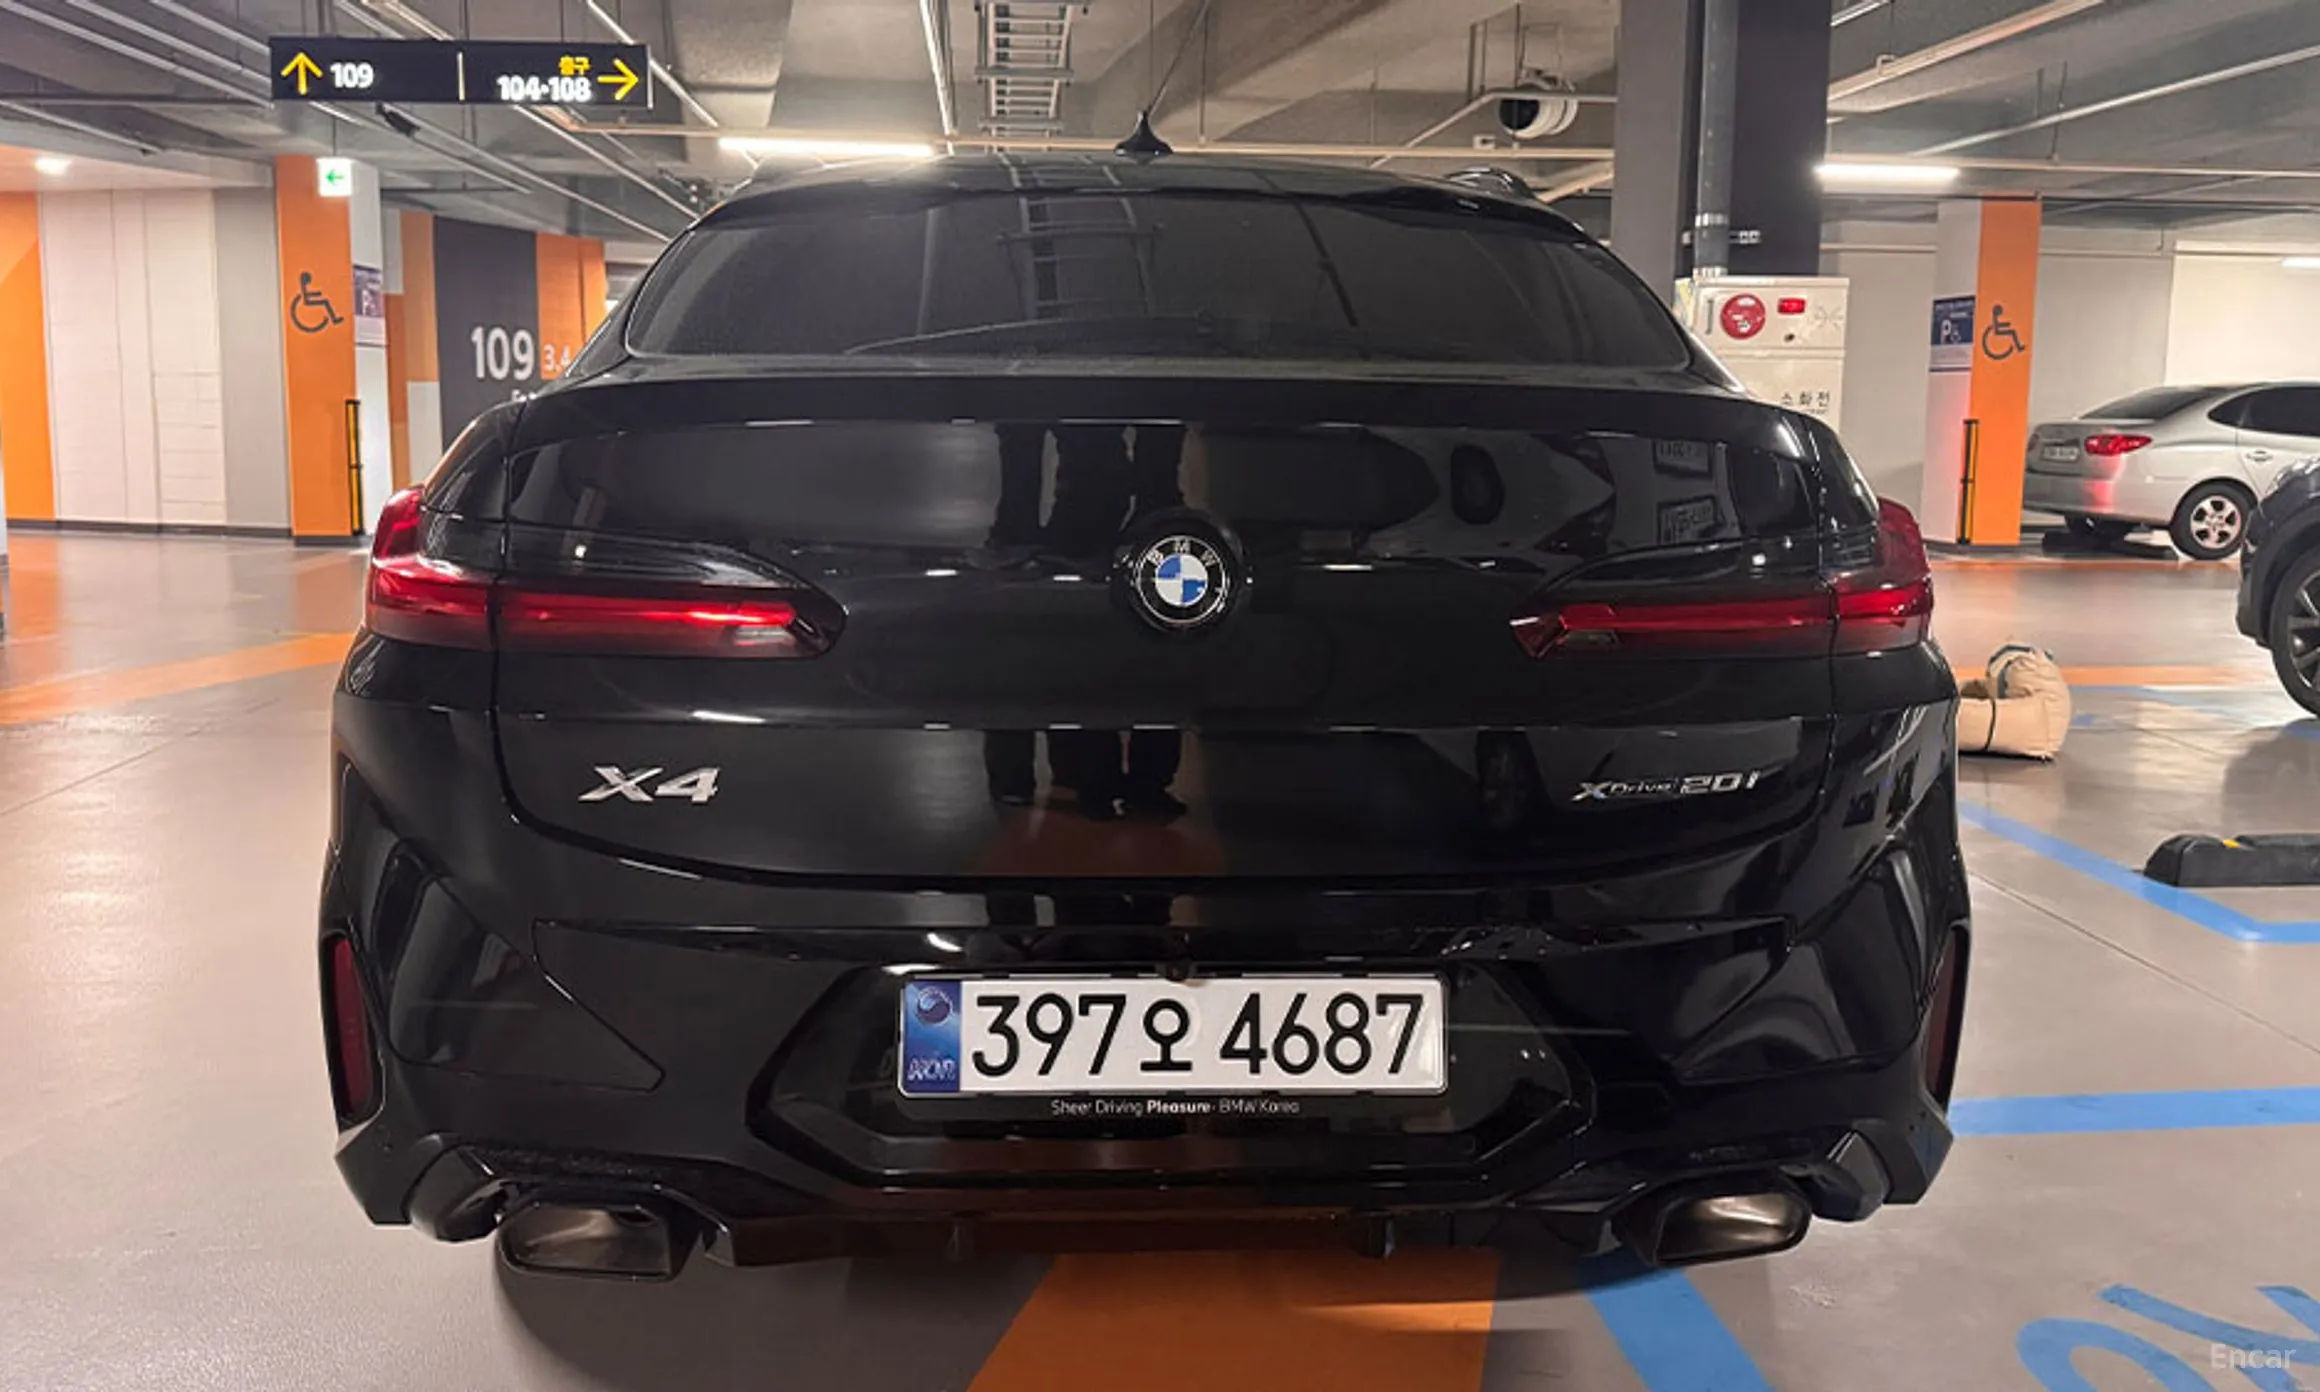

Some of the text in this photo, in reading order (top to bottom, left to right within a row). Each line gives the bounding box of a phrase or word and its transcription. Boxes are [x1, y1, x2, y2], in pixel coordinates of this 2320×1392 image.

[330, 62, 374, 88] 109
[471, 326, 535, 380] 109
[578, 766, 720, 802] X4
[1219, 992, 1424, 1075] 4687
[1095, 1099, 1144, 1117] Driving
[1219, 1099, 1258, 1114] BMW
